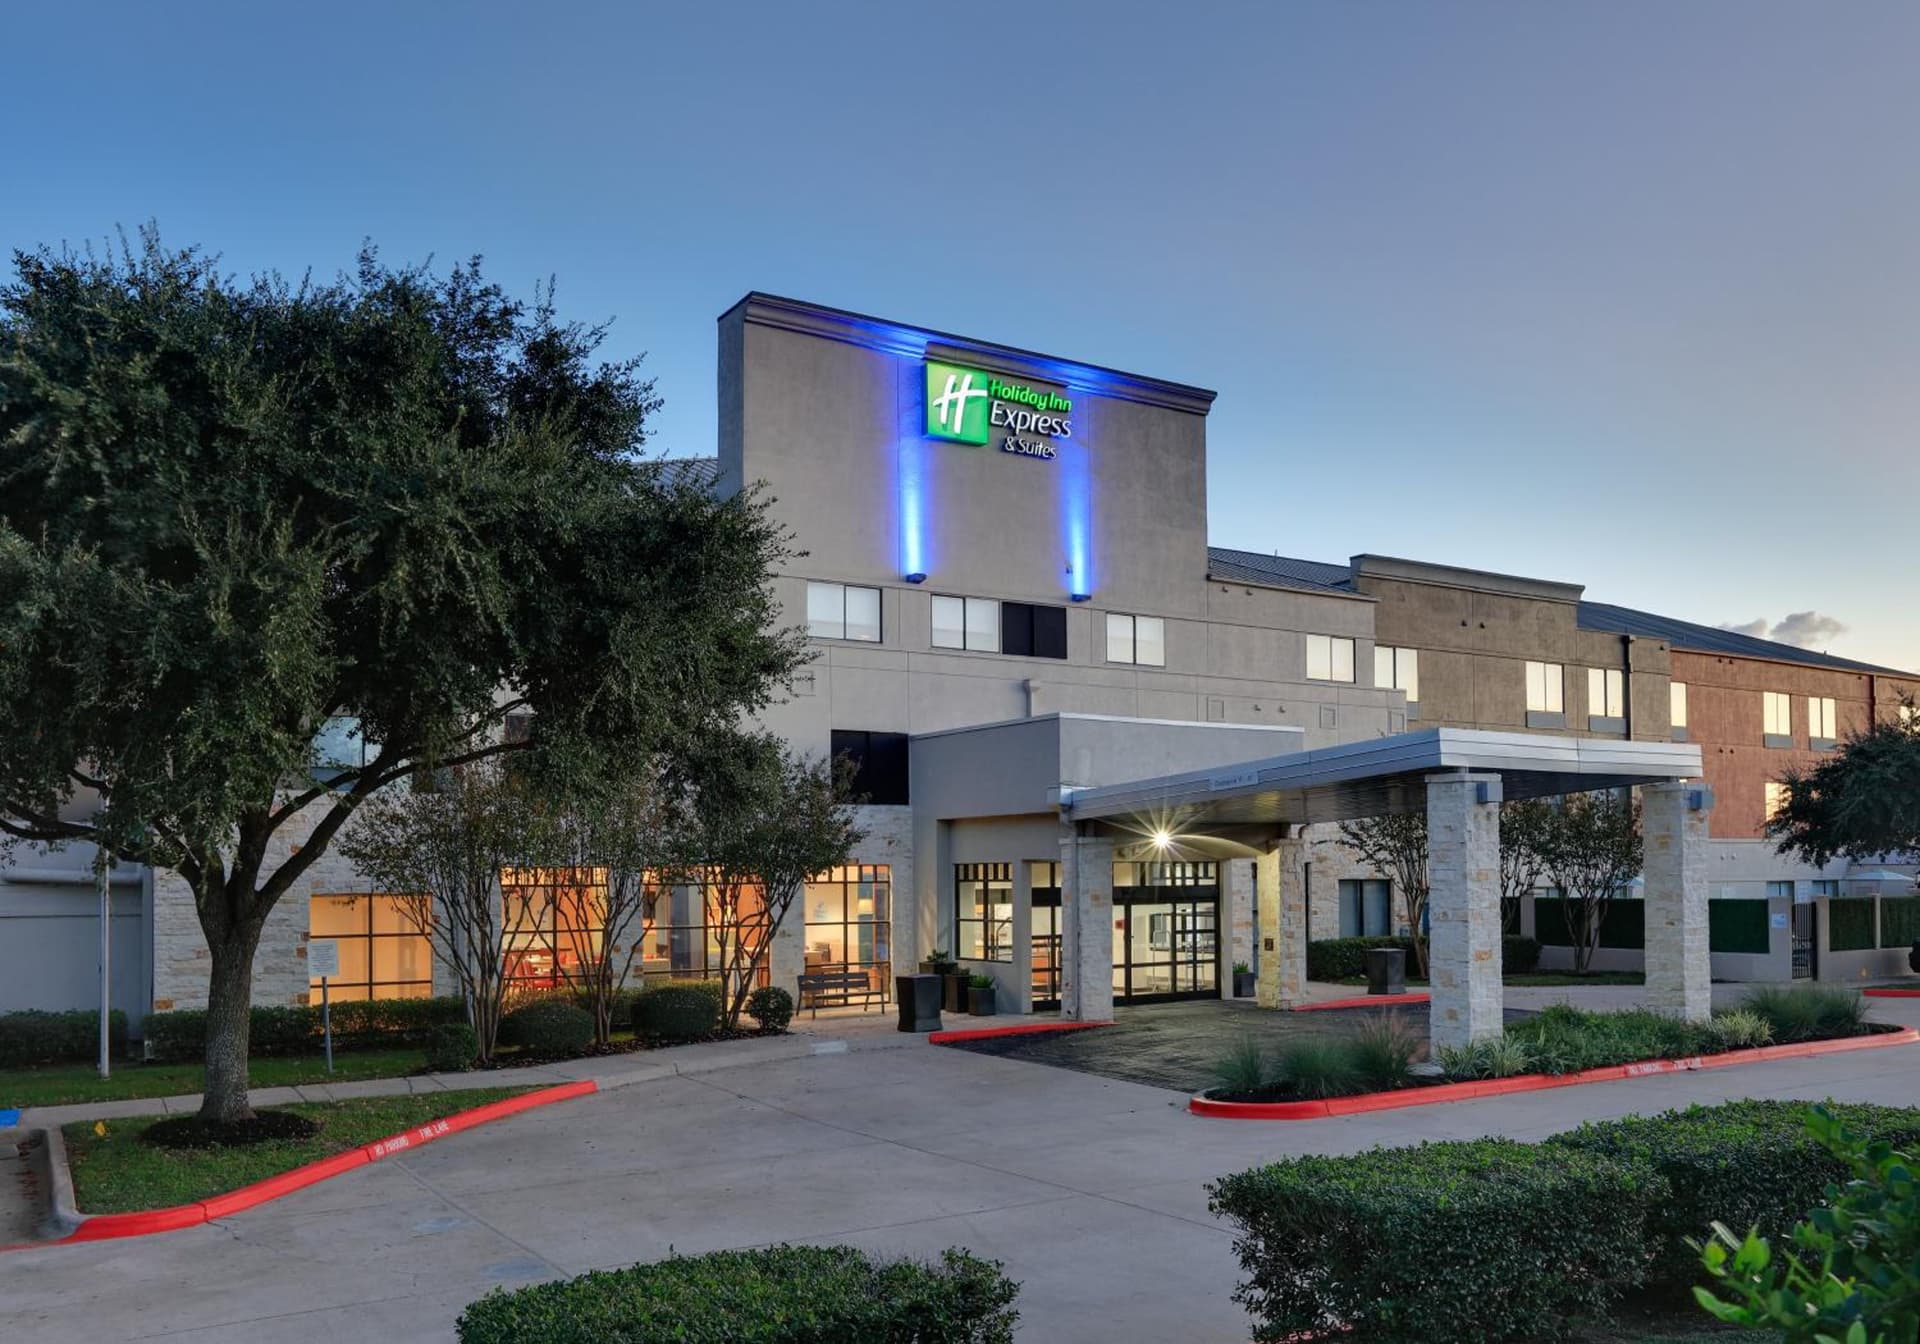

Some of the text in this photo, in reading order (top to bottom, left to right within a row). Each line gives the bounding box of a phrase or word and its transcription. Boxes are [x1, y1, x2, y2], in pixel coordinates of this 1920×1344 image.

[932, 374, 987, 434] H
[991, 380, 1072, 411] Holiday Inn
[991, 401, 1072, 438] Express
[1004, 436, 1057, 459] & Suites
